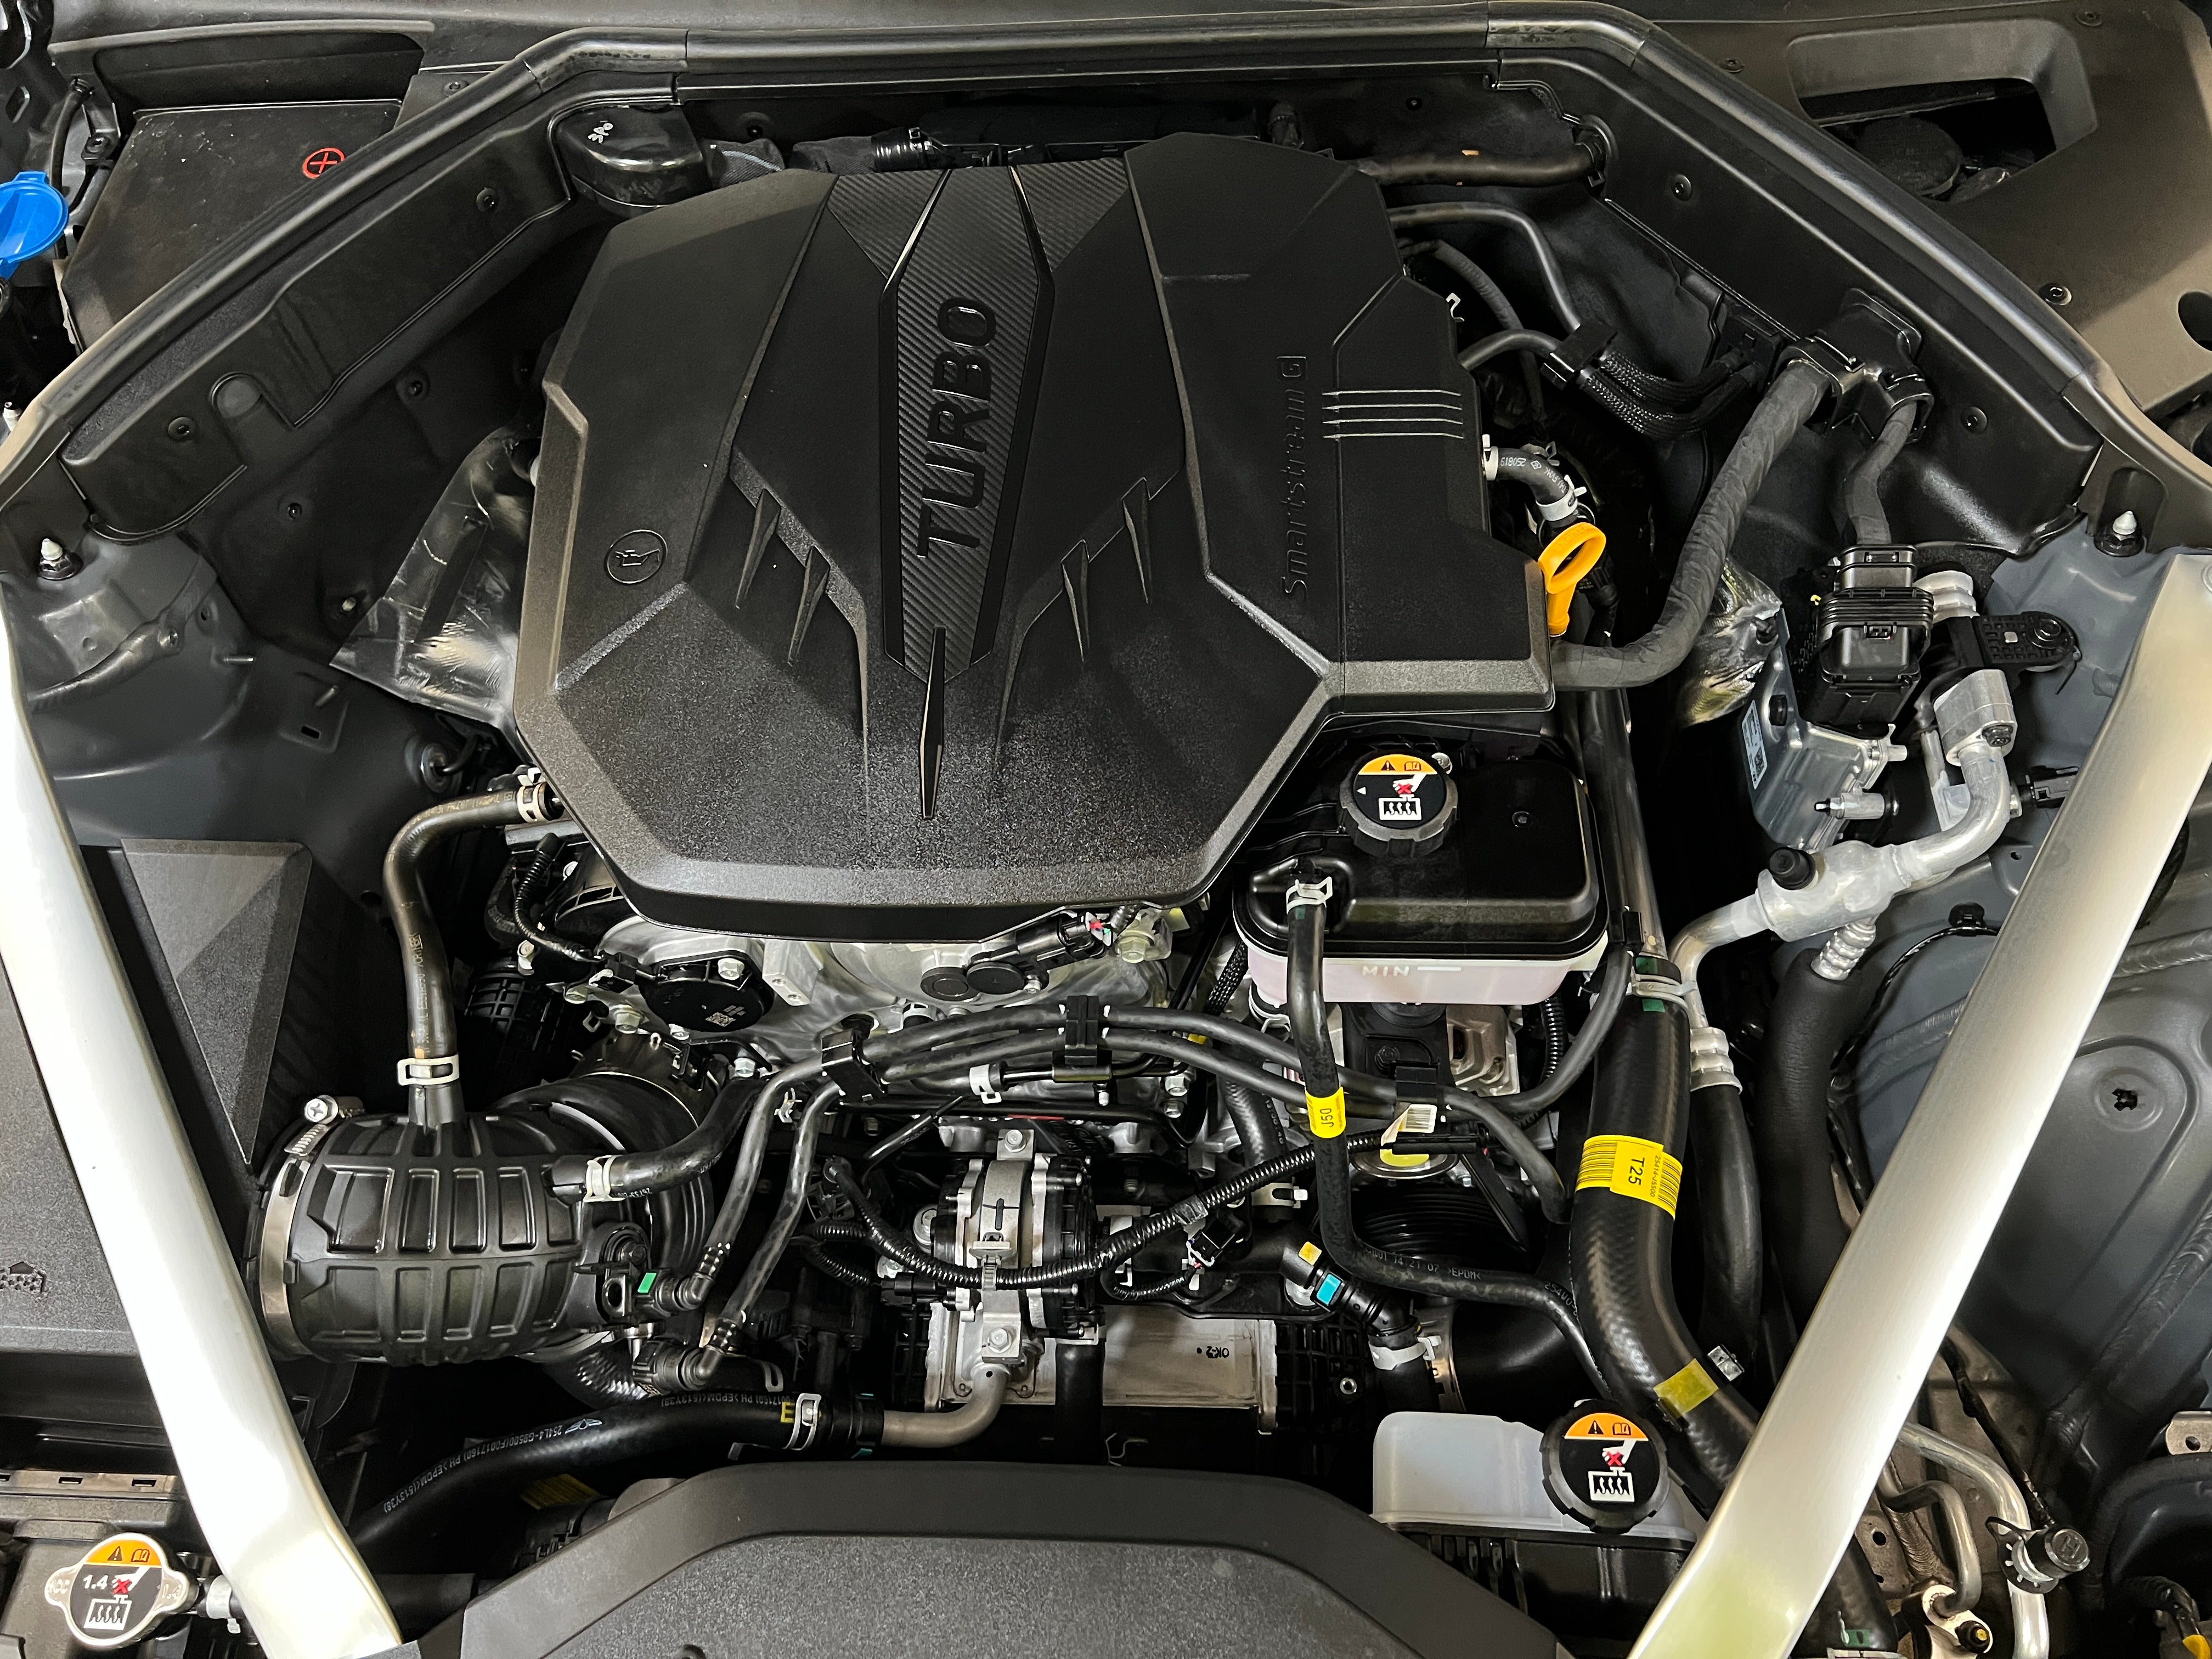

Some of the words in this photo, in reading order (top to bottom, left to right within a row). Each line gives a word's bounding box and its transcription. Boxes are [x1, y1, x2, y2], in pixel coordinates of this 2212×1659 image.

[916, 297, 996, 558] TURBO
[1280, 388, 1308, 600] Smartstream
[1362, 966, 1409, 977] MIN
[1320, 1108, 1334, 1127] J50
[1628, 1157, 1645, 1186] T25
[1650, 1154, 1661, 1198] 25414-J5500
[83, 1573, 109, 1590] 1.4
